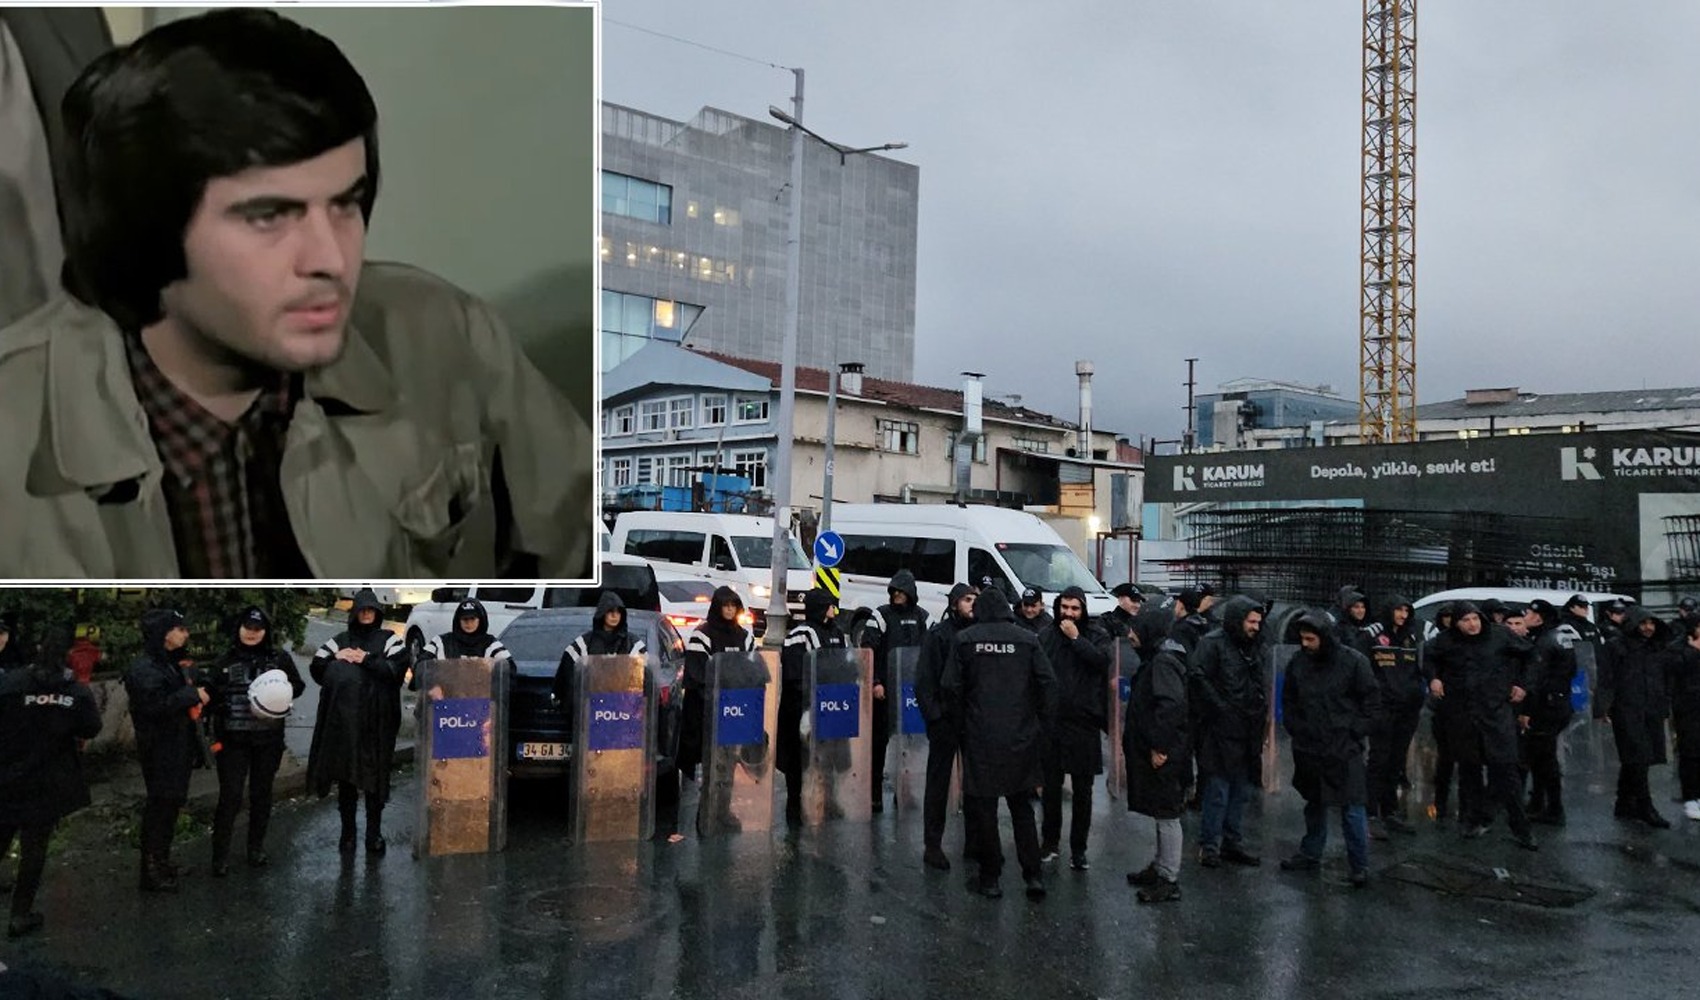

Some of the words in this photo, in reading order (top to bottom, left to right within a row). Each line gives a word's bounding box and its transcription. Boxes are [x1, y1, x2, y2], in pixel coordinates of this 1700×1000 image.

[1612, 447, 1700, 466] KARU
[1203, 464, 1264, 481] KARUM
[1310, 463, 1367, 480] Depola,
[1372, 461, 1422, 479] yükle,
[1426, 459, 1465, 475] sevk
[1470, 458, 1496, 473] et!
[1613, 467, 1662, 477] TİCARET
[820, 700, 850, 711] POLS
[524, 744, 537, 756] 34
[541, 743, 554, 756] GA
